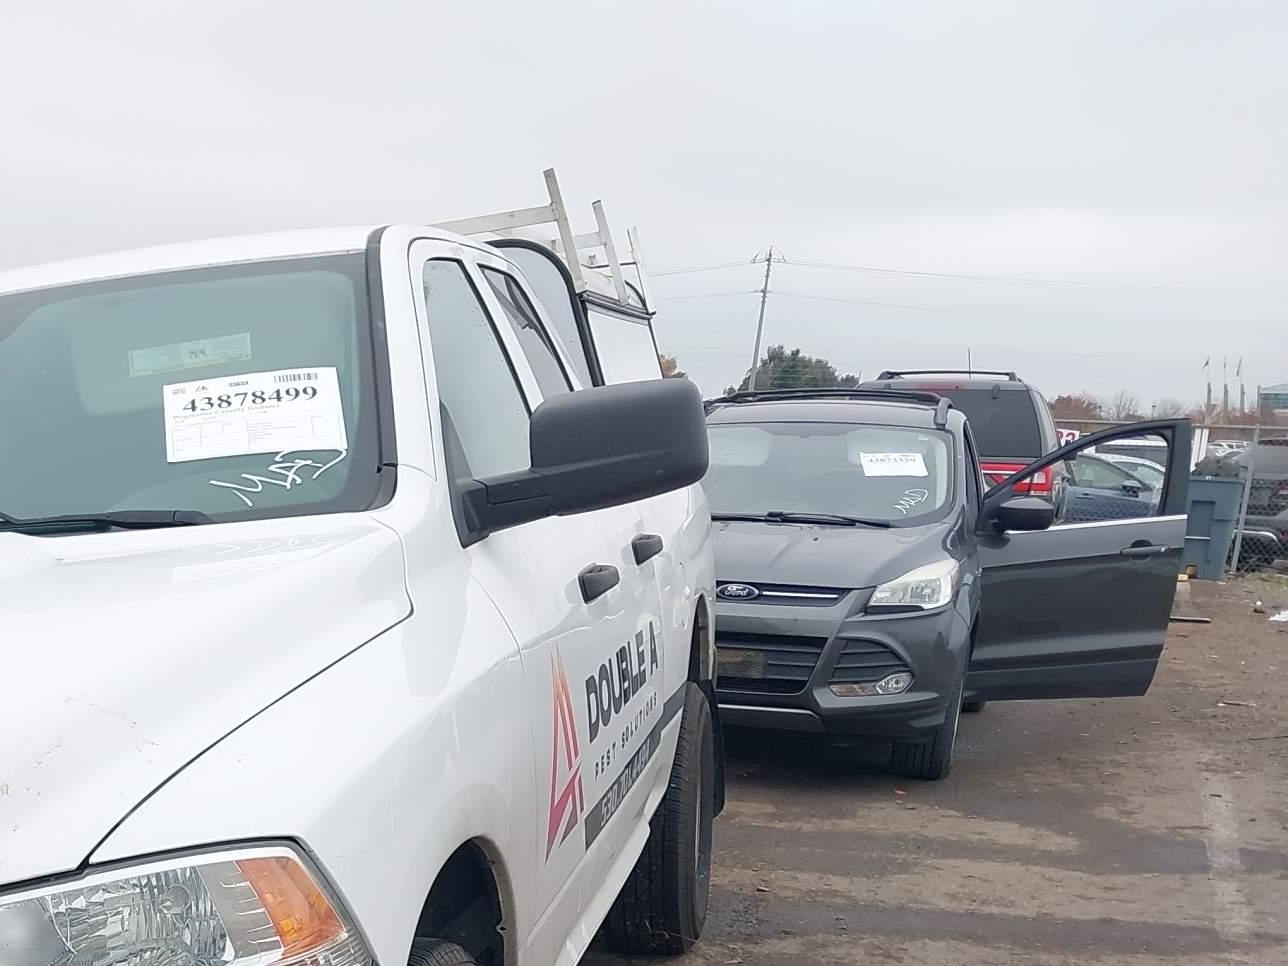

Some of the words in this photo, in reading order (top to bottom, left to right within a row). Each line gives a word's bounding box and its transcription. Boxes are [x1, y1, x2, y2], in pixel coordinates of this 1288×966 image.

[182, 385, 319, 413] 43878499
[724, 585, 749, 597] Ford
[585, 629, 647, 745] DOUBLE
[648, 620, 659, 676] A
[594, 742, 617, 782] PEST
[621, 691, 658, 750] SOLUTIONS
